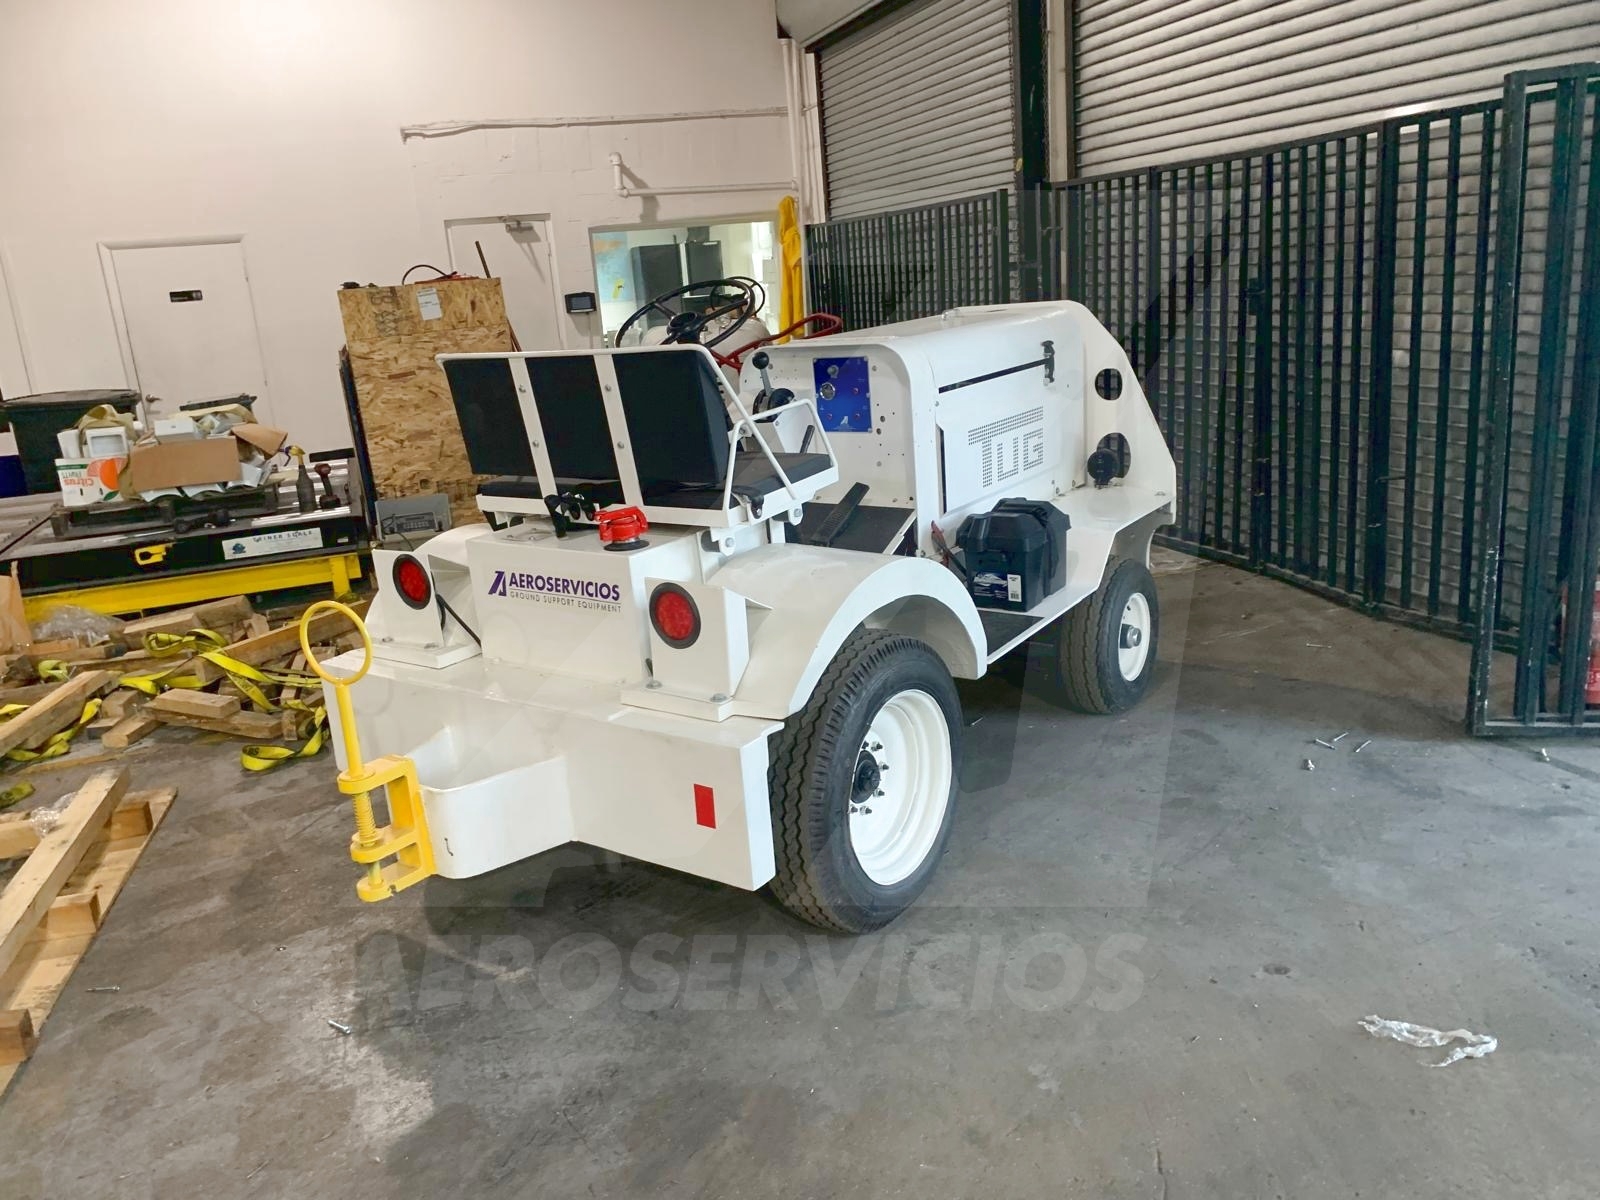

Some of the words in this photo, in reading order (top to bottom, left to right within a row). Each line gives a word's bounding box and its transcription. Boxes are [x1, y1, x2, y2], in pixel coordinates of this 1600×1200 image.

[967, 406, 1044, 488] TUG
[509, 572, 621, 602] AEROSERVICIOS
[510, 590, 541, 602] GROUND
[543, 595, 575, 607] SUPPORT
[577, 600, 622, 613] EQUIPMENT
